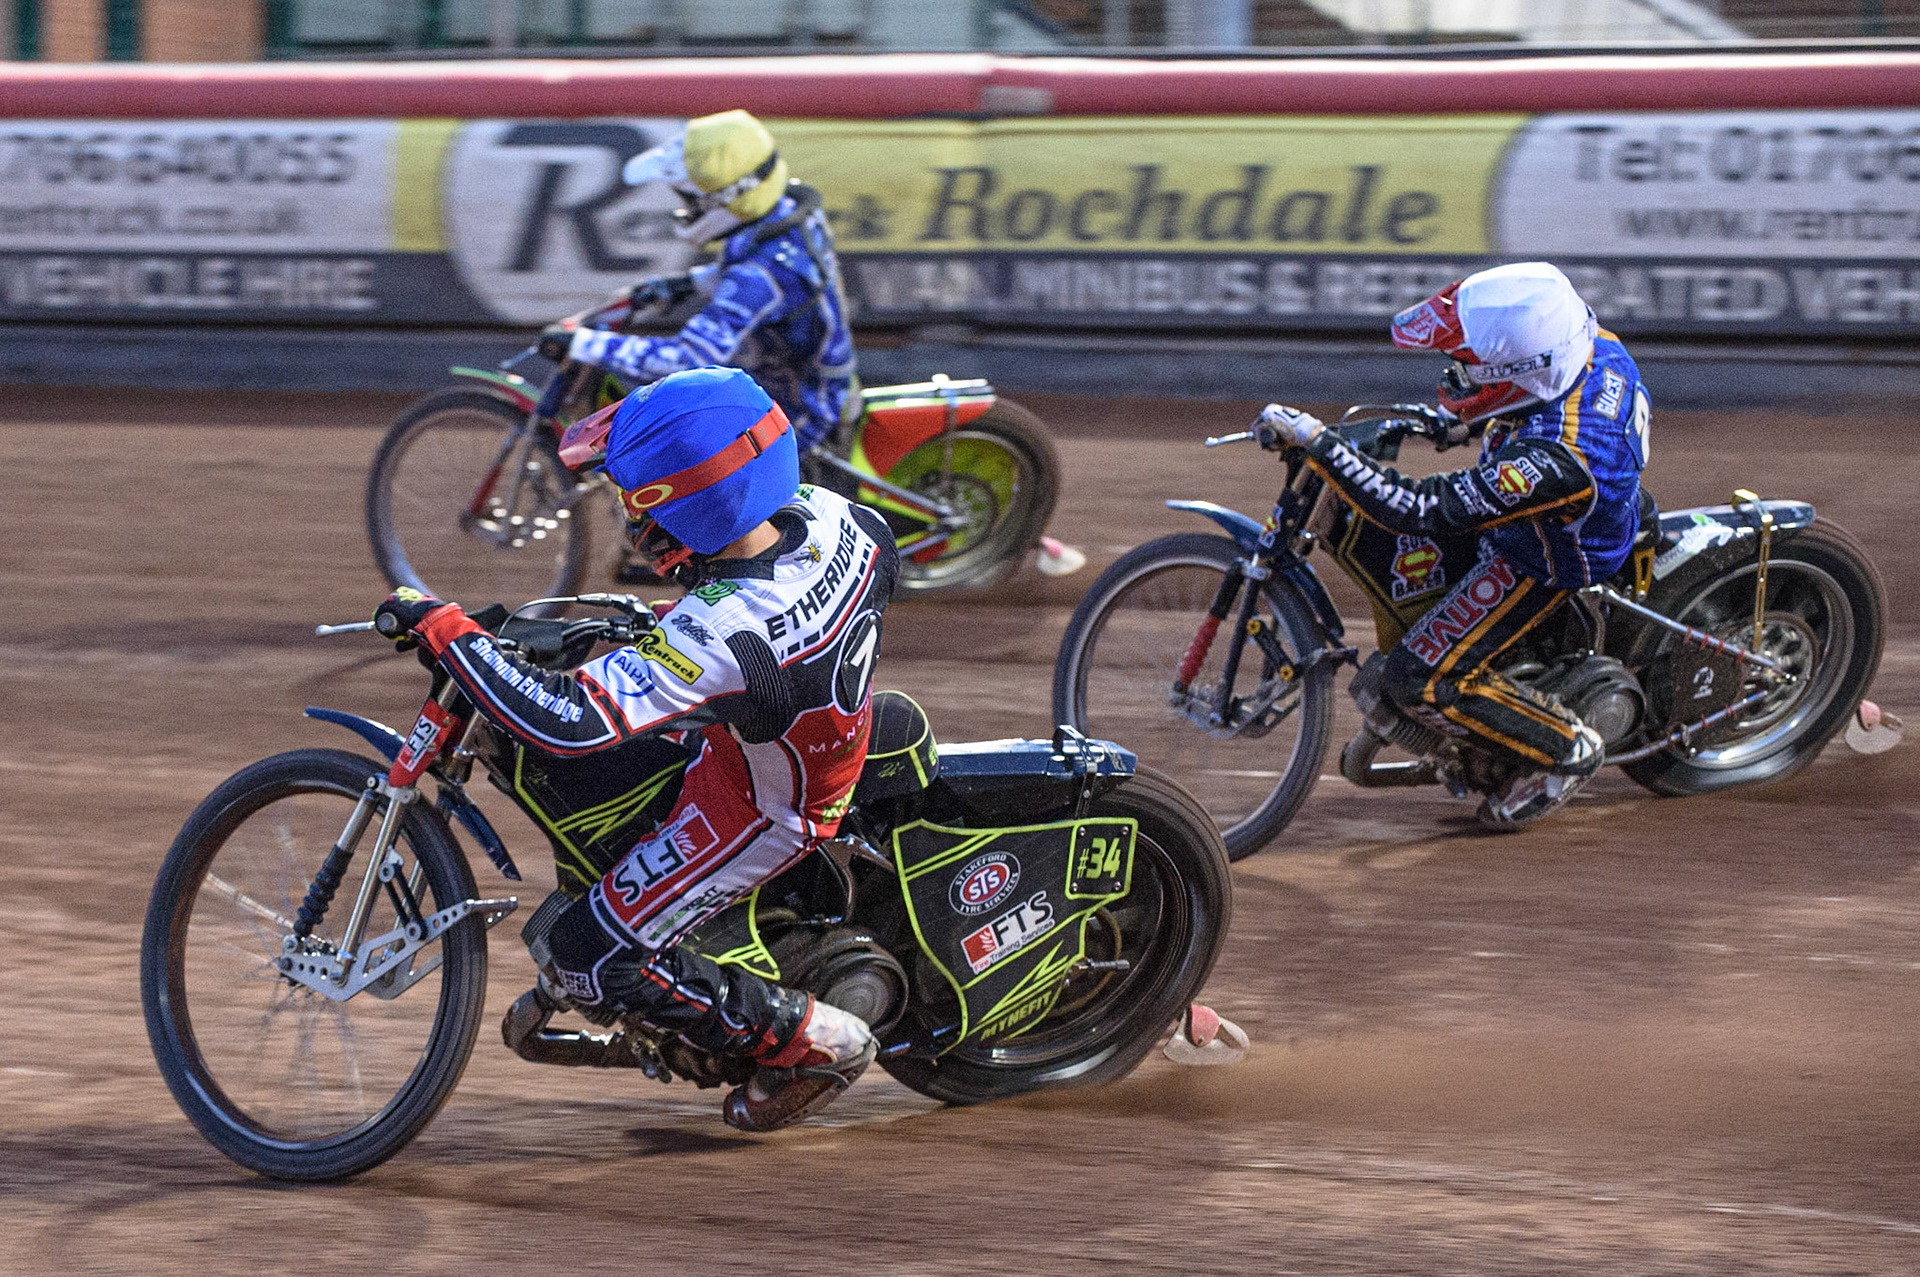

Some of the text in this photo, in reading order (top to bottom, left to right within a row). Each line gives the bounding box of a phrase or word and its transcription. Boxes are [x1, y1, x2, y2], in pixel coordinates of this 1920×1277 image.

[915, 164, 1442, 246] Rochdale
[1012, 259, 1257, 313] MINIBUS
[1327, 442, 1439, 518] MIKEY
[1515, 459, 1541, 484] SUE
[765, 518, 859, 642] ETHERIDGE
[469, 636, 584, 723] Shannon Etheridge
[636, 633, 697, 681] Rentruck
[407, 718, 433, 752] FTS
[613, 838, 686, 904] FTS
[955, 854, 1007, 886] STAKEFORD
[968, 868, 1001, 900] STS
[1077, 837, 1121, 879] #34
[991, 892, 1053, 947] FTS
[973, 920, 1054, 973] Fire Training Services
